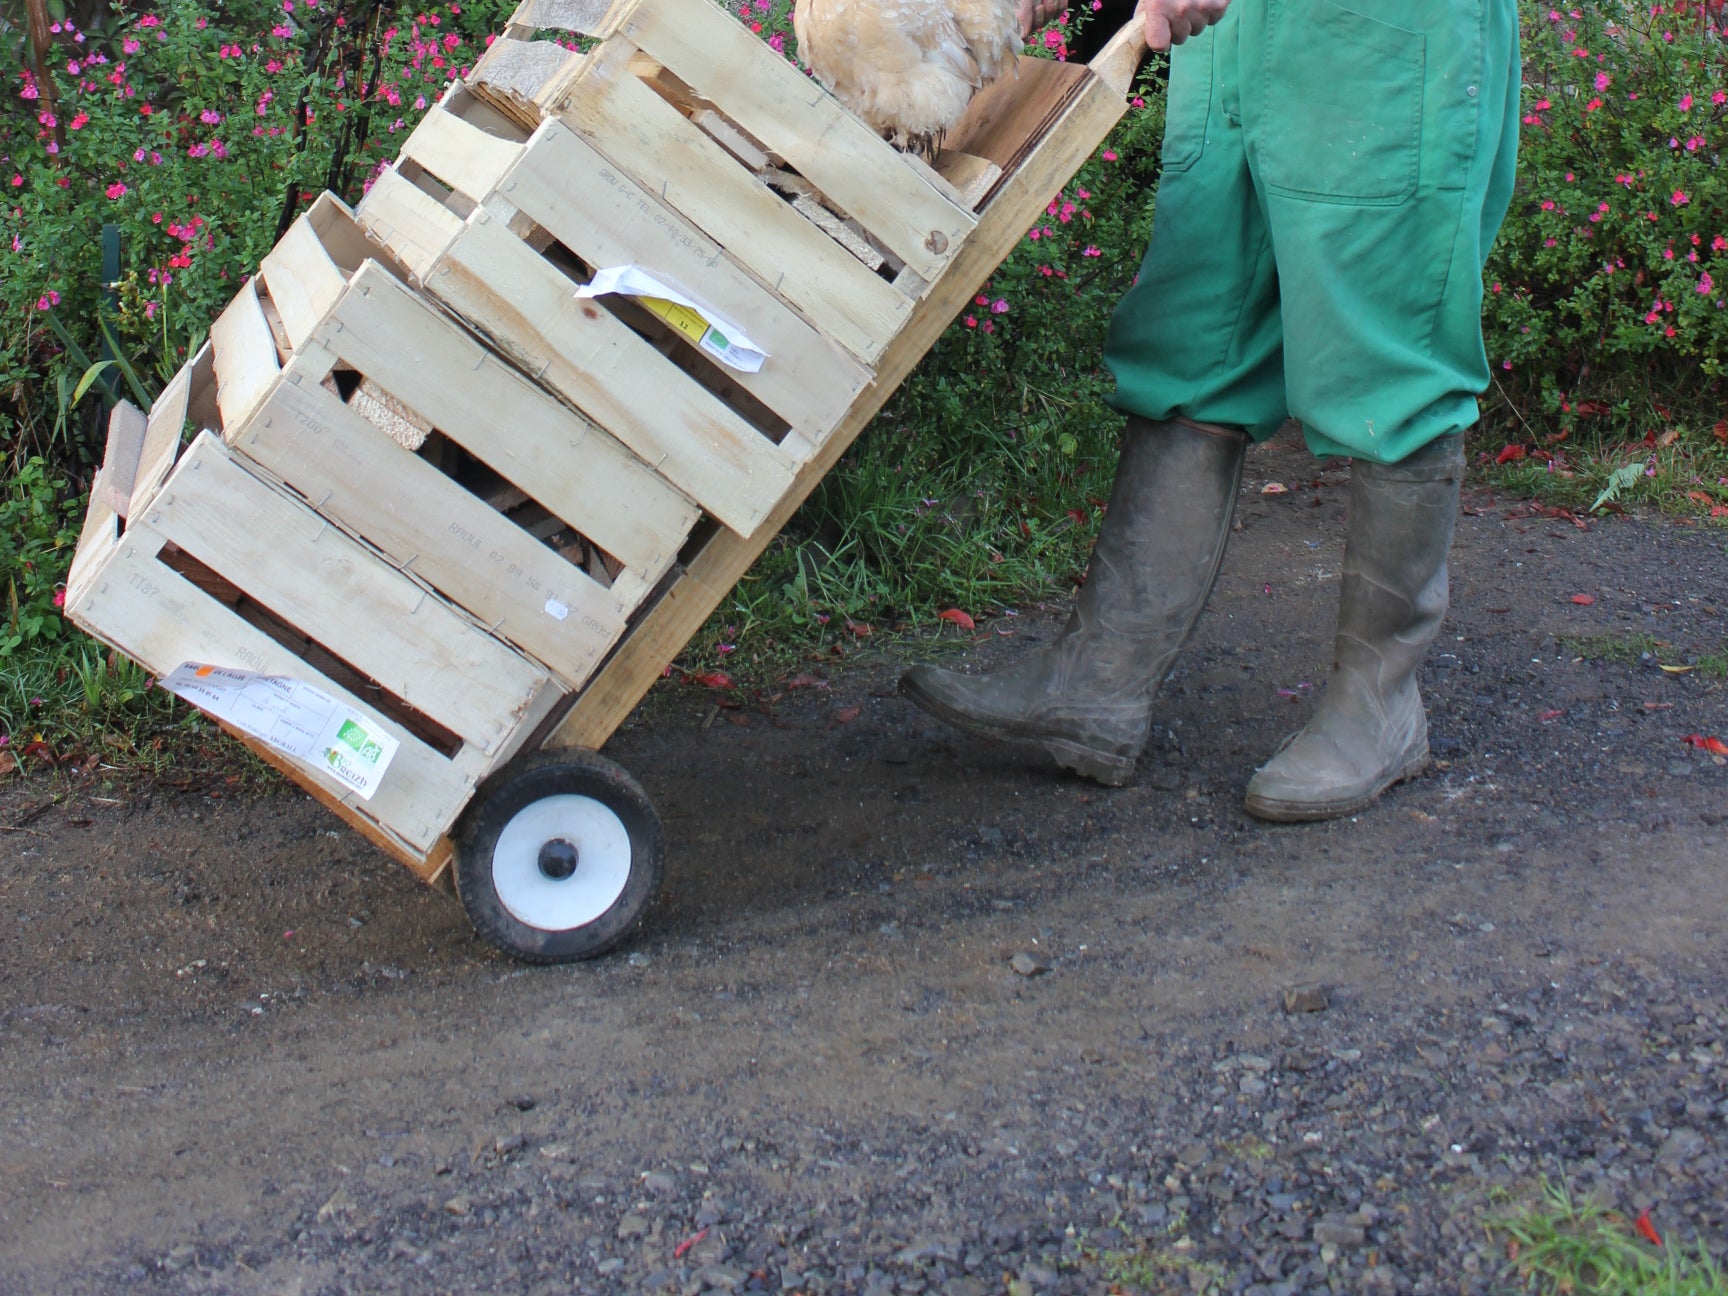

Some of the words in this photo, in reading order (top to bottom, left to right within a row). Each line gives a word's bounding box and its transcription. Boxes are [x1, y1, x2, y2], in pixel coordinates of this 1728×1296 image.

[637, 199, 650, 215] TEL
[679, 321, 689, 331] 12
[448, 521, 482, 552] RAOUL
[489, 551, 505, 563] 02
